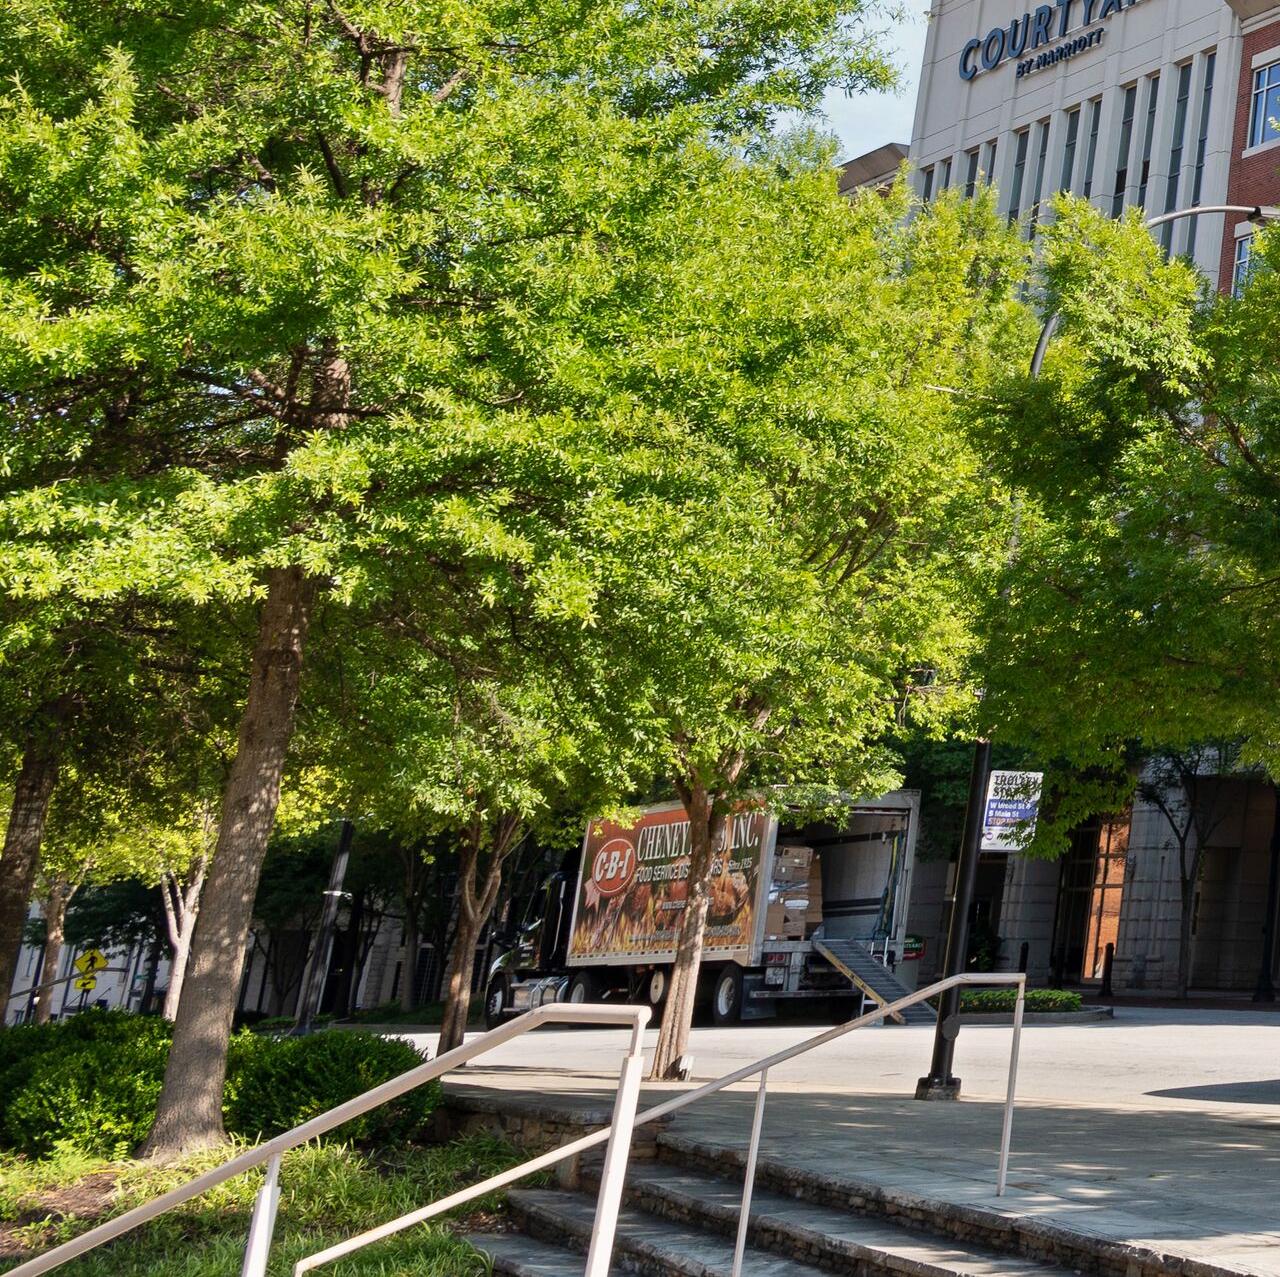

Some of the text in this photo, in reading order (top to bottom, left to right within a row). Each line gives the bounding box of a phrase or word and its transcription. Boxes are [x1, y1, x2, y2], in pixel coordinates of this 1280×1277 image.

[1016, 27, 1104, 78] BY MARRIOTT
[995, 810, 1011, 818] Main
[1012, 810, 1019, 818] St
[637, 820, 691, 862] CHENEY
[730, 812, 759, 850] INC.
[594, 848, 633, 883] C-B-I
[637, 866, 653, 883] FOOD
[653, 863, 678, 881] SERVICE
